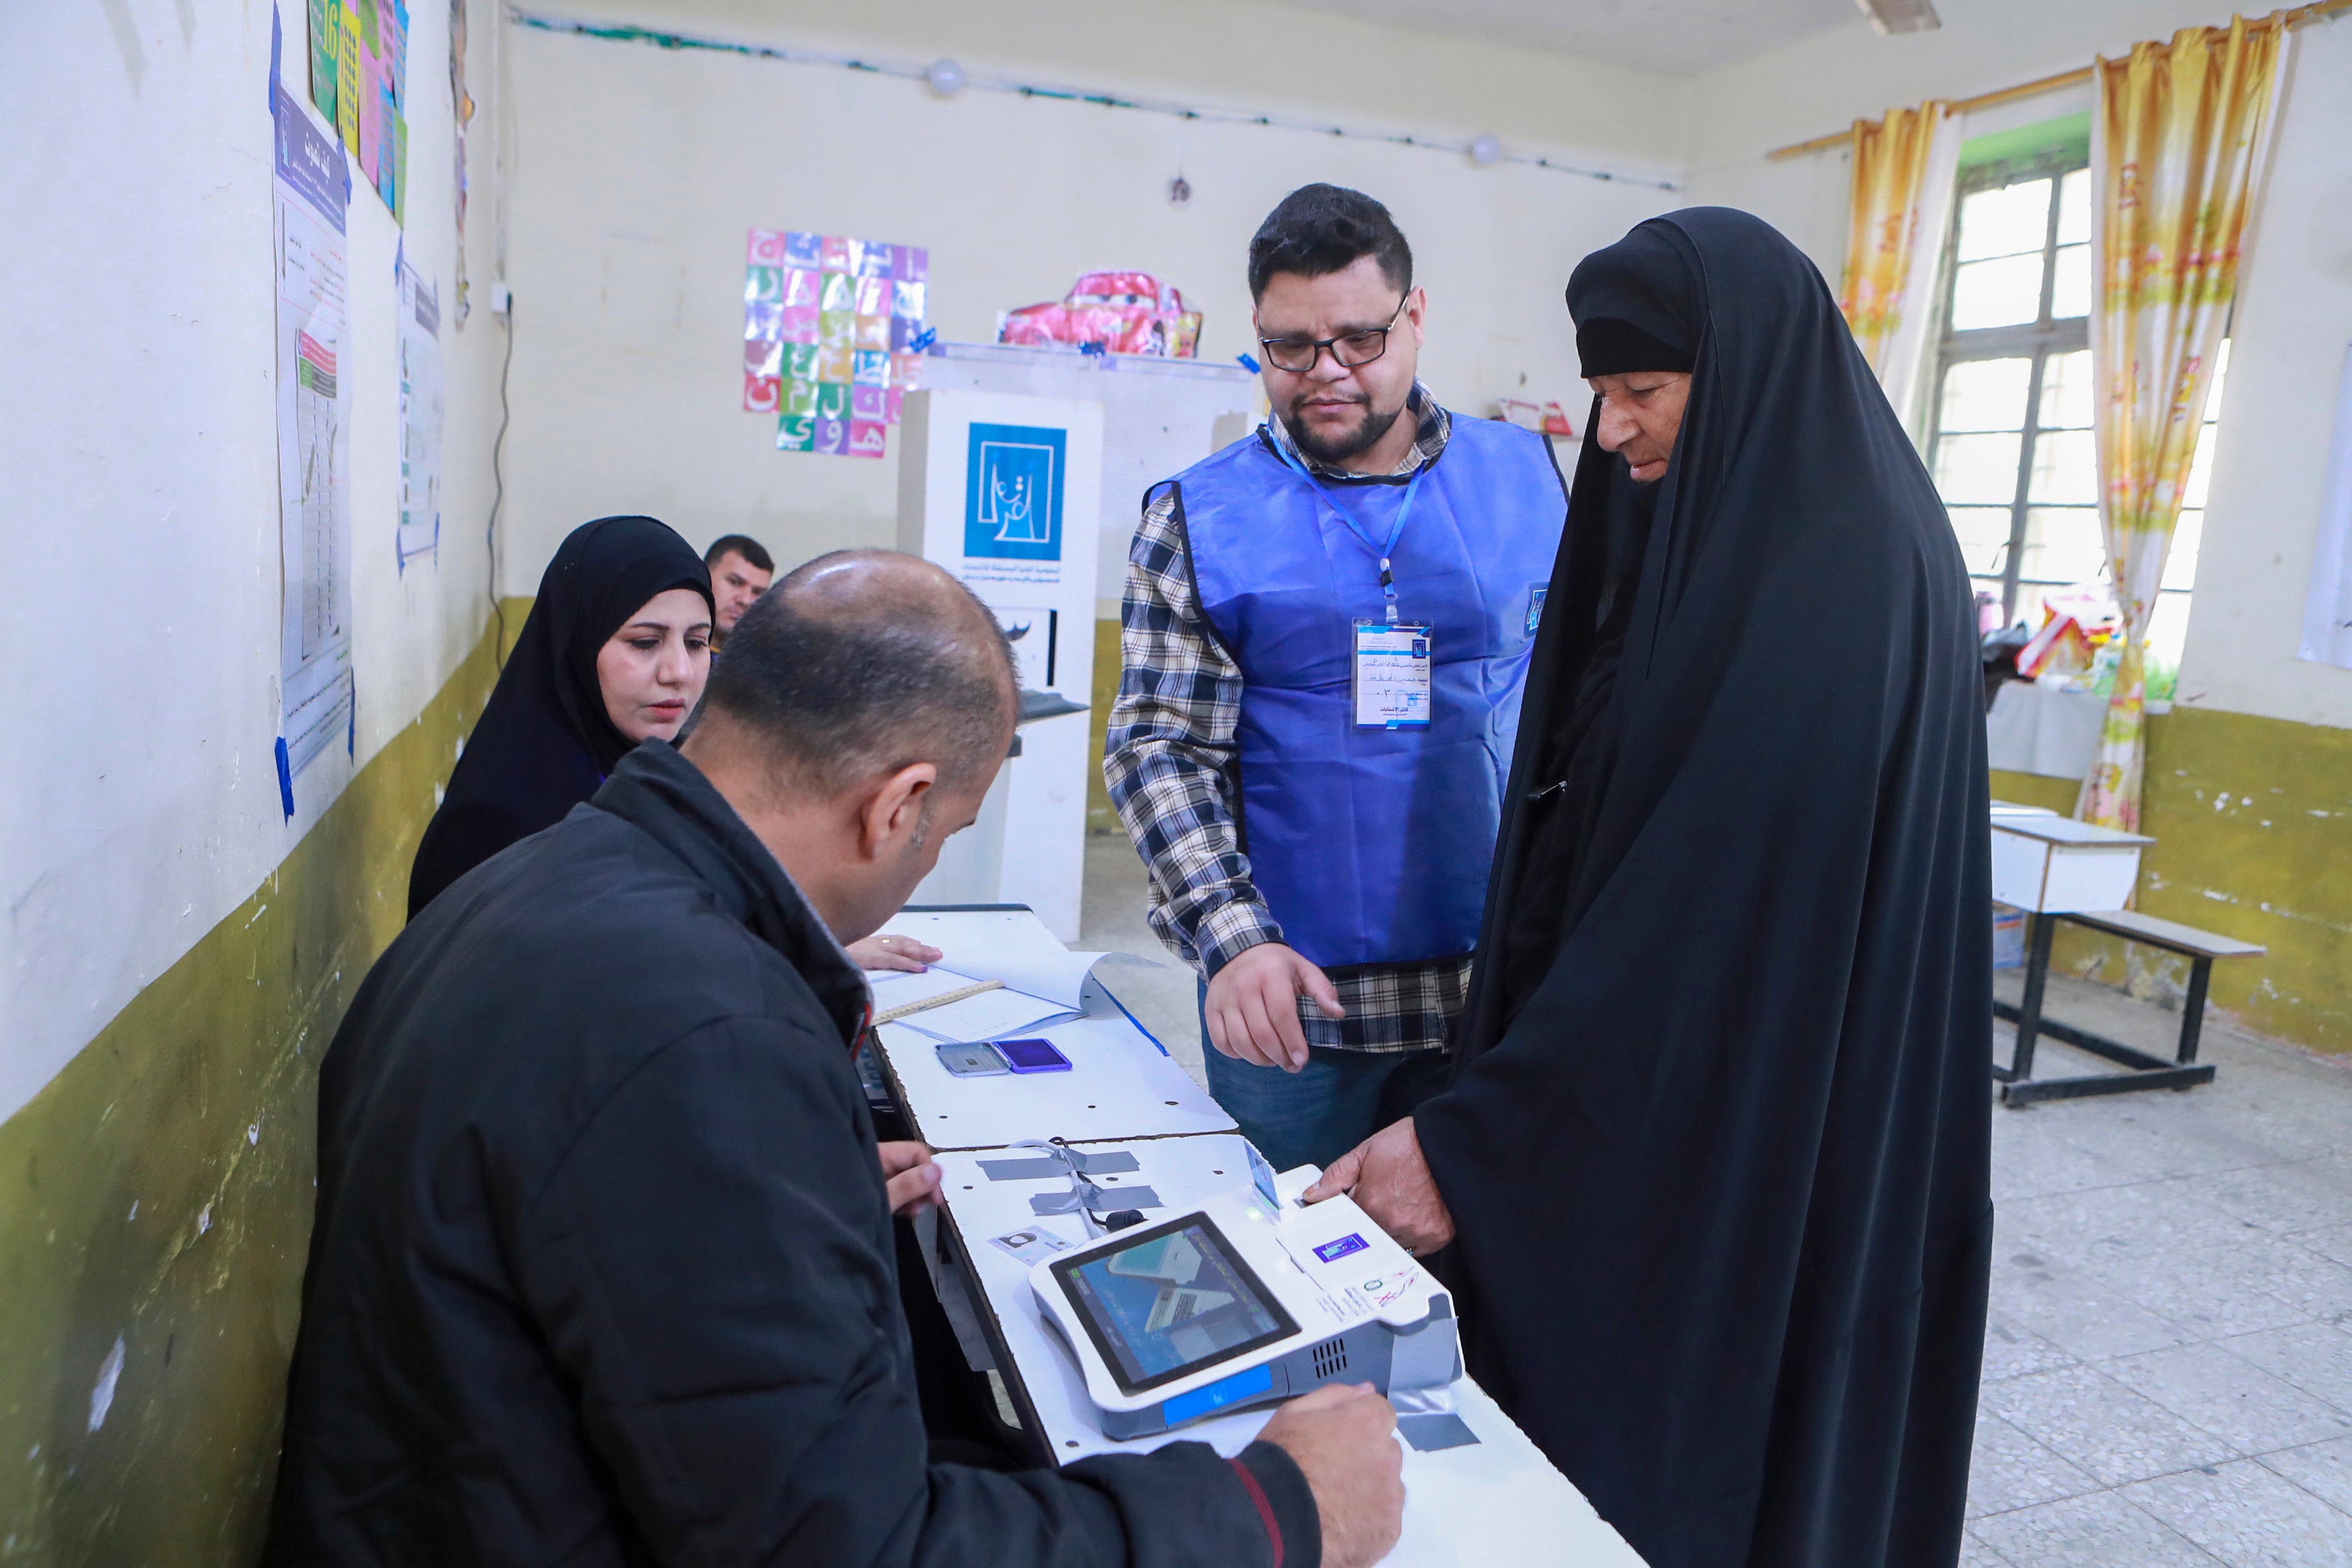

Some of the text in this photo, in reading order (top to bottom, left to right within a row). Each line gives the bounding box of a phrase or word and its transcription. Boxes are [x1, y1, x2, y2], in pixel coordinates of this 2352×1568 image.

[747, 376, 778, 411] ن
[822, 386, 844, 420] ل
[778, 418, 812, 450] ي
[820, 420, 843, 453] و
